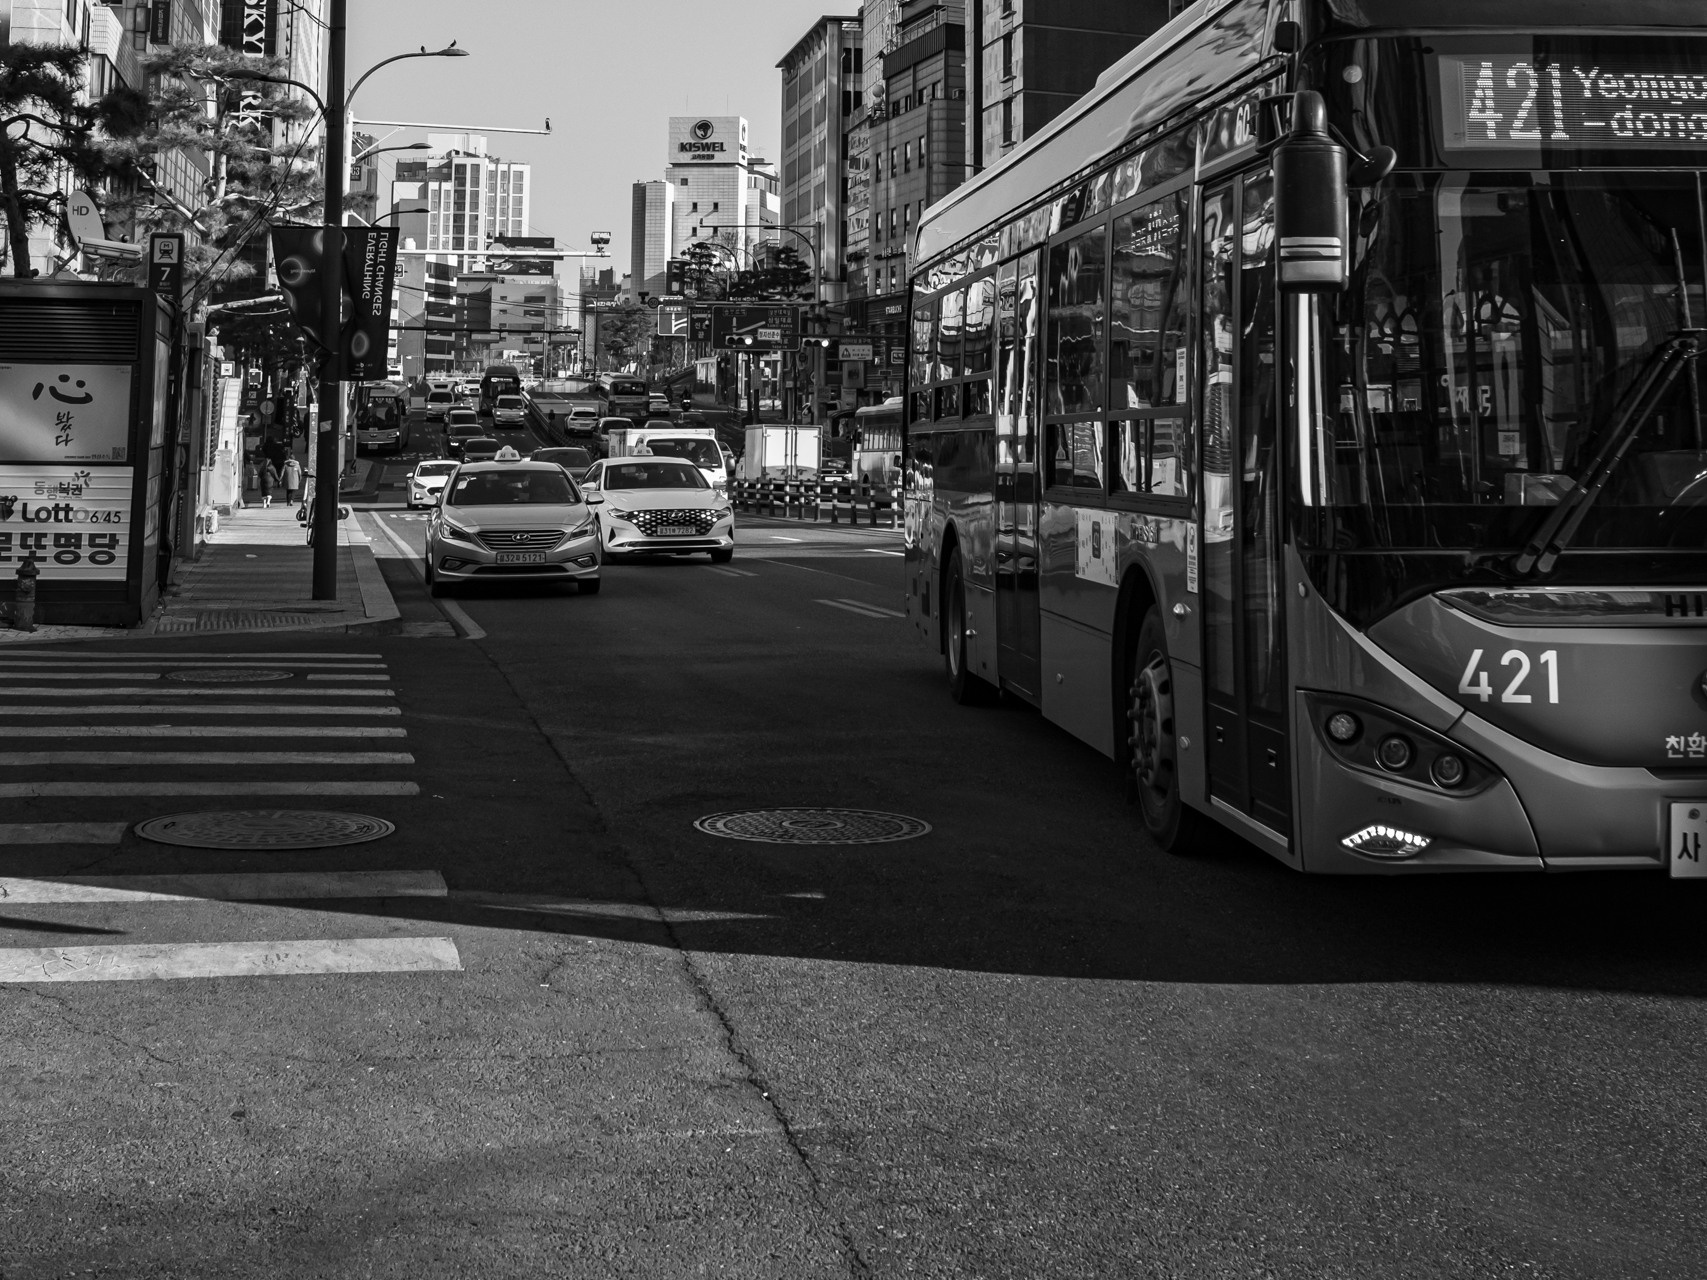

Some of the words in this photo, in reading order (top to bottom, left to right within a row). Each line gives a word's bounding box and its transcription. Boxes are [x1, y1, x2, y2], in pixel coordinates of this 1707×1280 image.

[1468, 62, 1570, 140] 421
[679, 142, 727, 152] KISWEL
[72, 205, 90, 216] HD
[161, 267, 171, 280] 7
[21, 502, 90, 523] Lotto
[90, 510, 122, 524] 6/45
[1458, 648, 1559, 704] 421
[1677, 831, 1702, 863] 사
